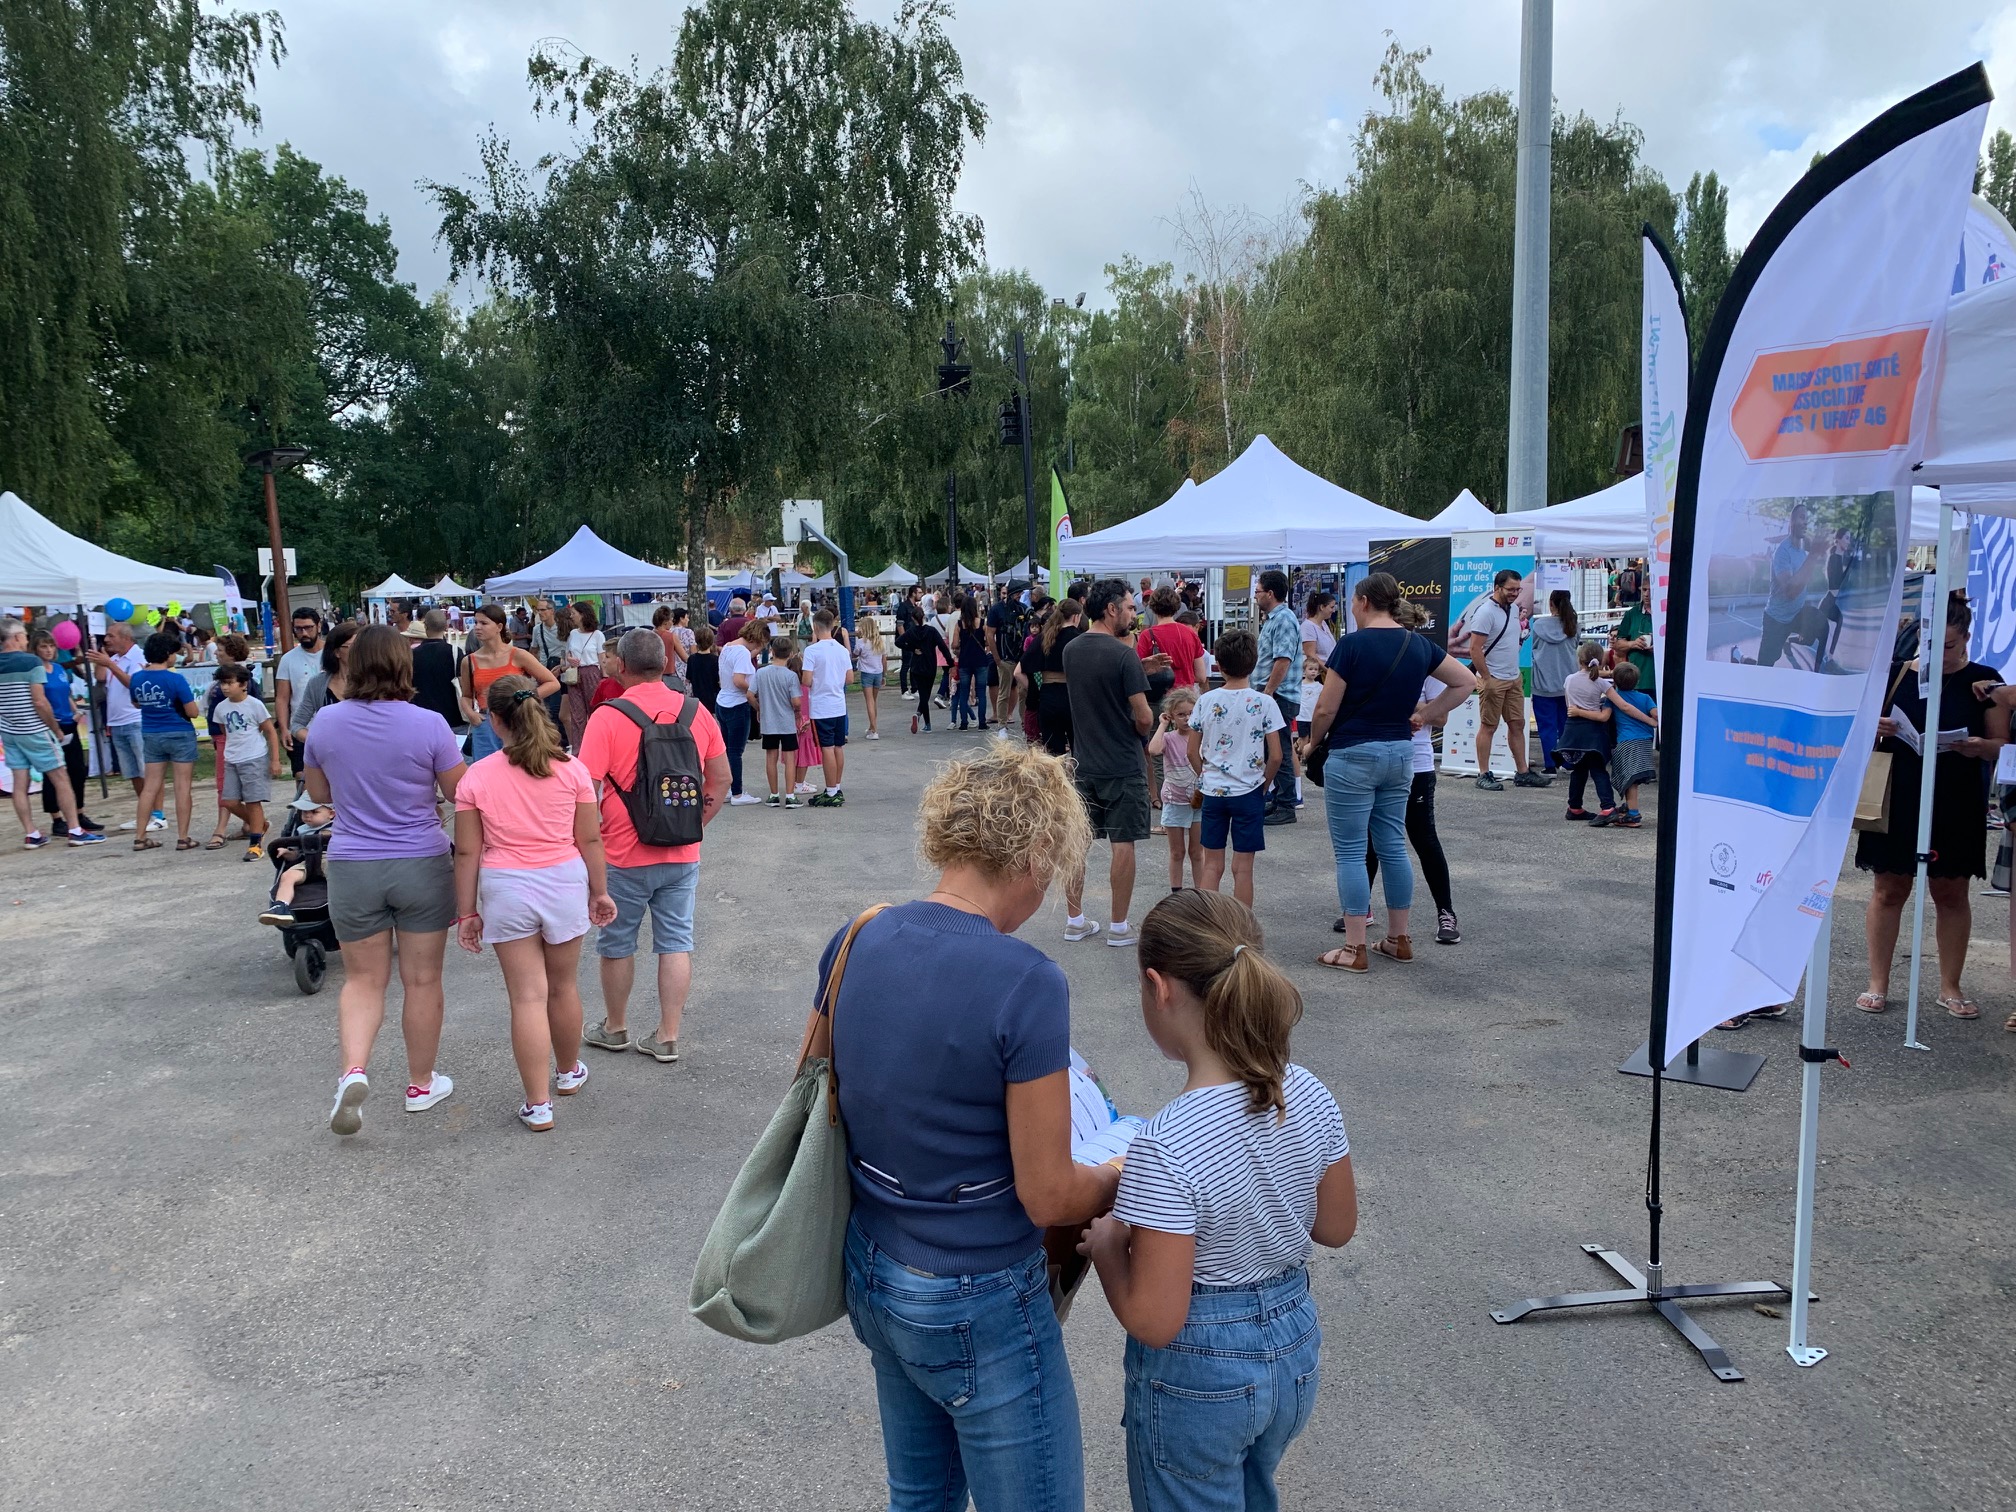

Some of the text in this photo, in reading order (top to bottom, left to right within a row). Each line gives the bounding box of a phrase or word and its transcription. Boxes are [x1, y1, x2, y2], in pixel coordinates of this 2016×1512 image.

[1772, 369, 1814, 392] MAIS
[1864, 406, 1888, 427] 46
[1453, 560, 1493, 573] Du Rugby
[1453, 573, 1472, 583] pour
[1474, 571, 1490, 581] des
[1398, 579, 1442, 600] Sports
[1452, 584, 1466, 594] par
[1468, 582, 1484, 592] des
